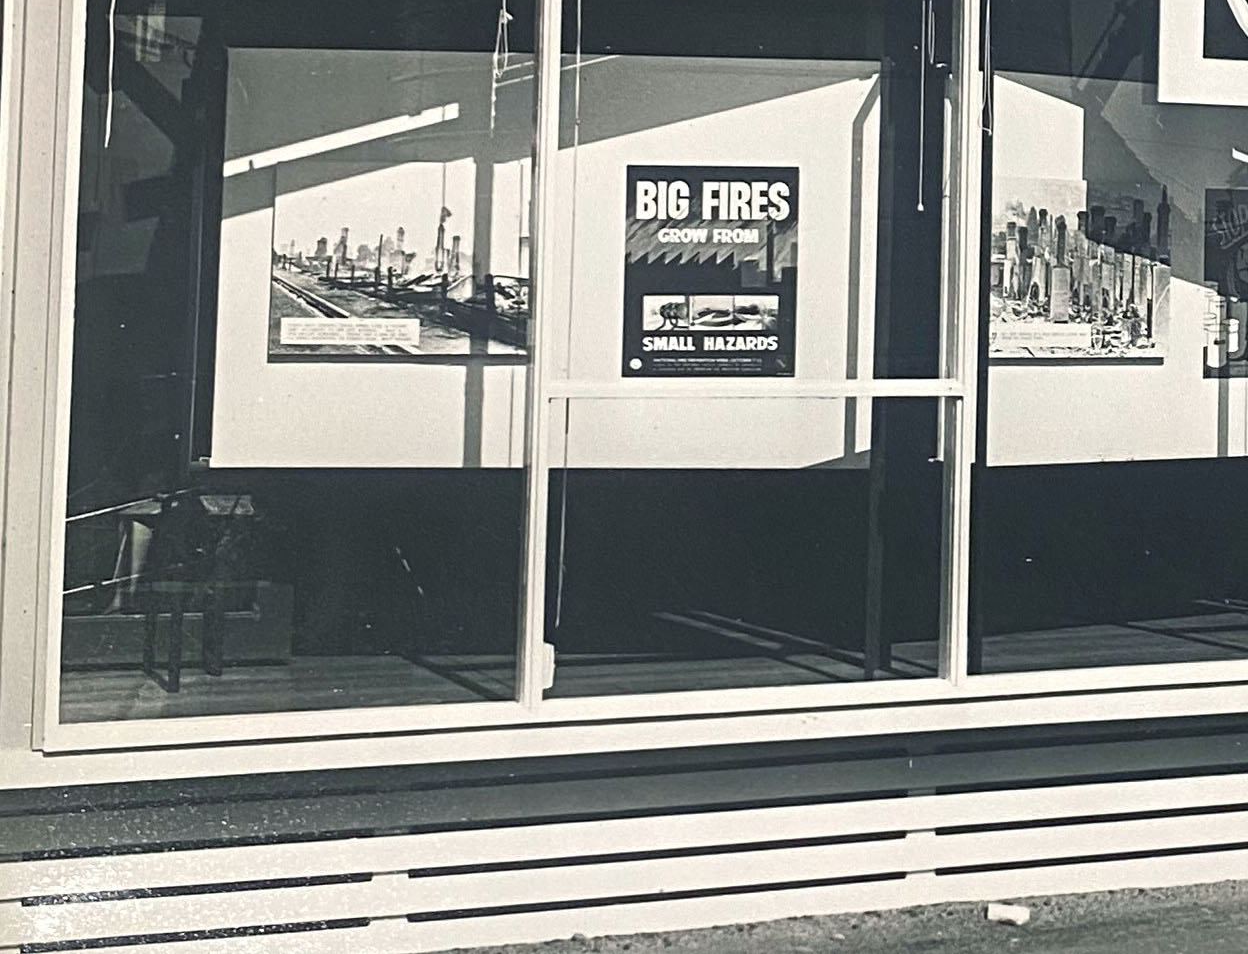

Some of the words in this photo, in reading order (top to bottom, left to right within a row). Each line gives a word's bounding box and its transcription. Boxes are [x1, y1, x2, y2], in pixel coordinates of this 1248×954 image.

[636, 181, 690, 220] BIG
[702, 181, 791, 222] FIRES
[657, 228, 709, 244] GROW
[712, 228, 760, 244] FROM
[641, 335, 696, 352] SMALL
[702, 335, 779, 352] HAZARDS
